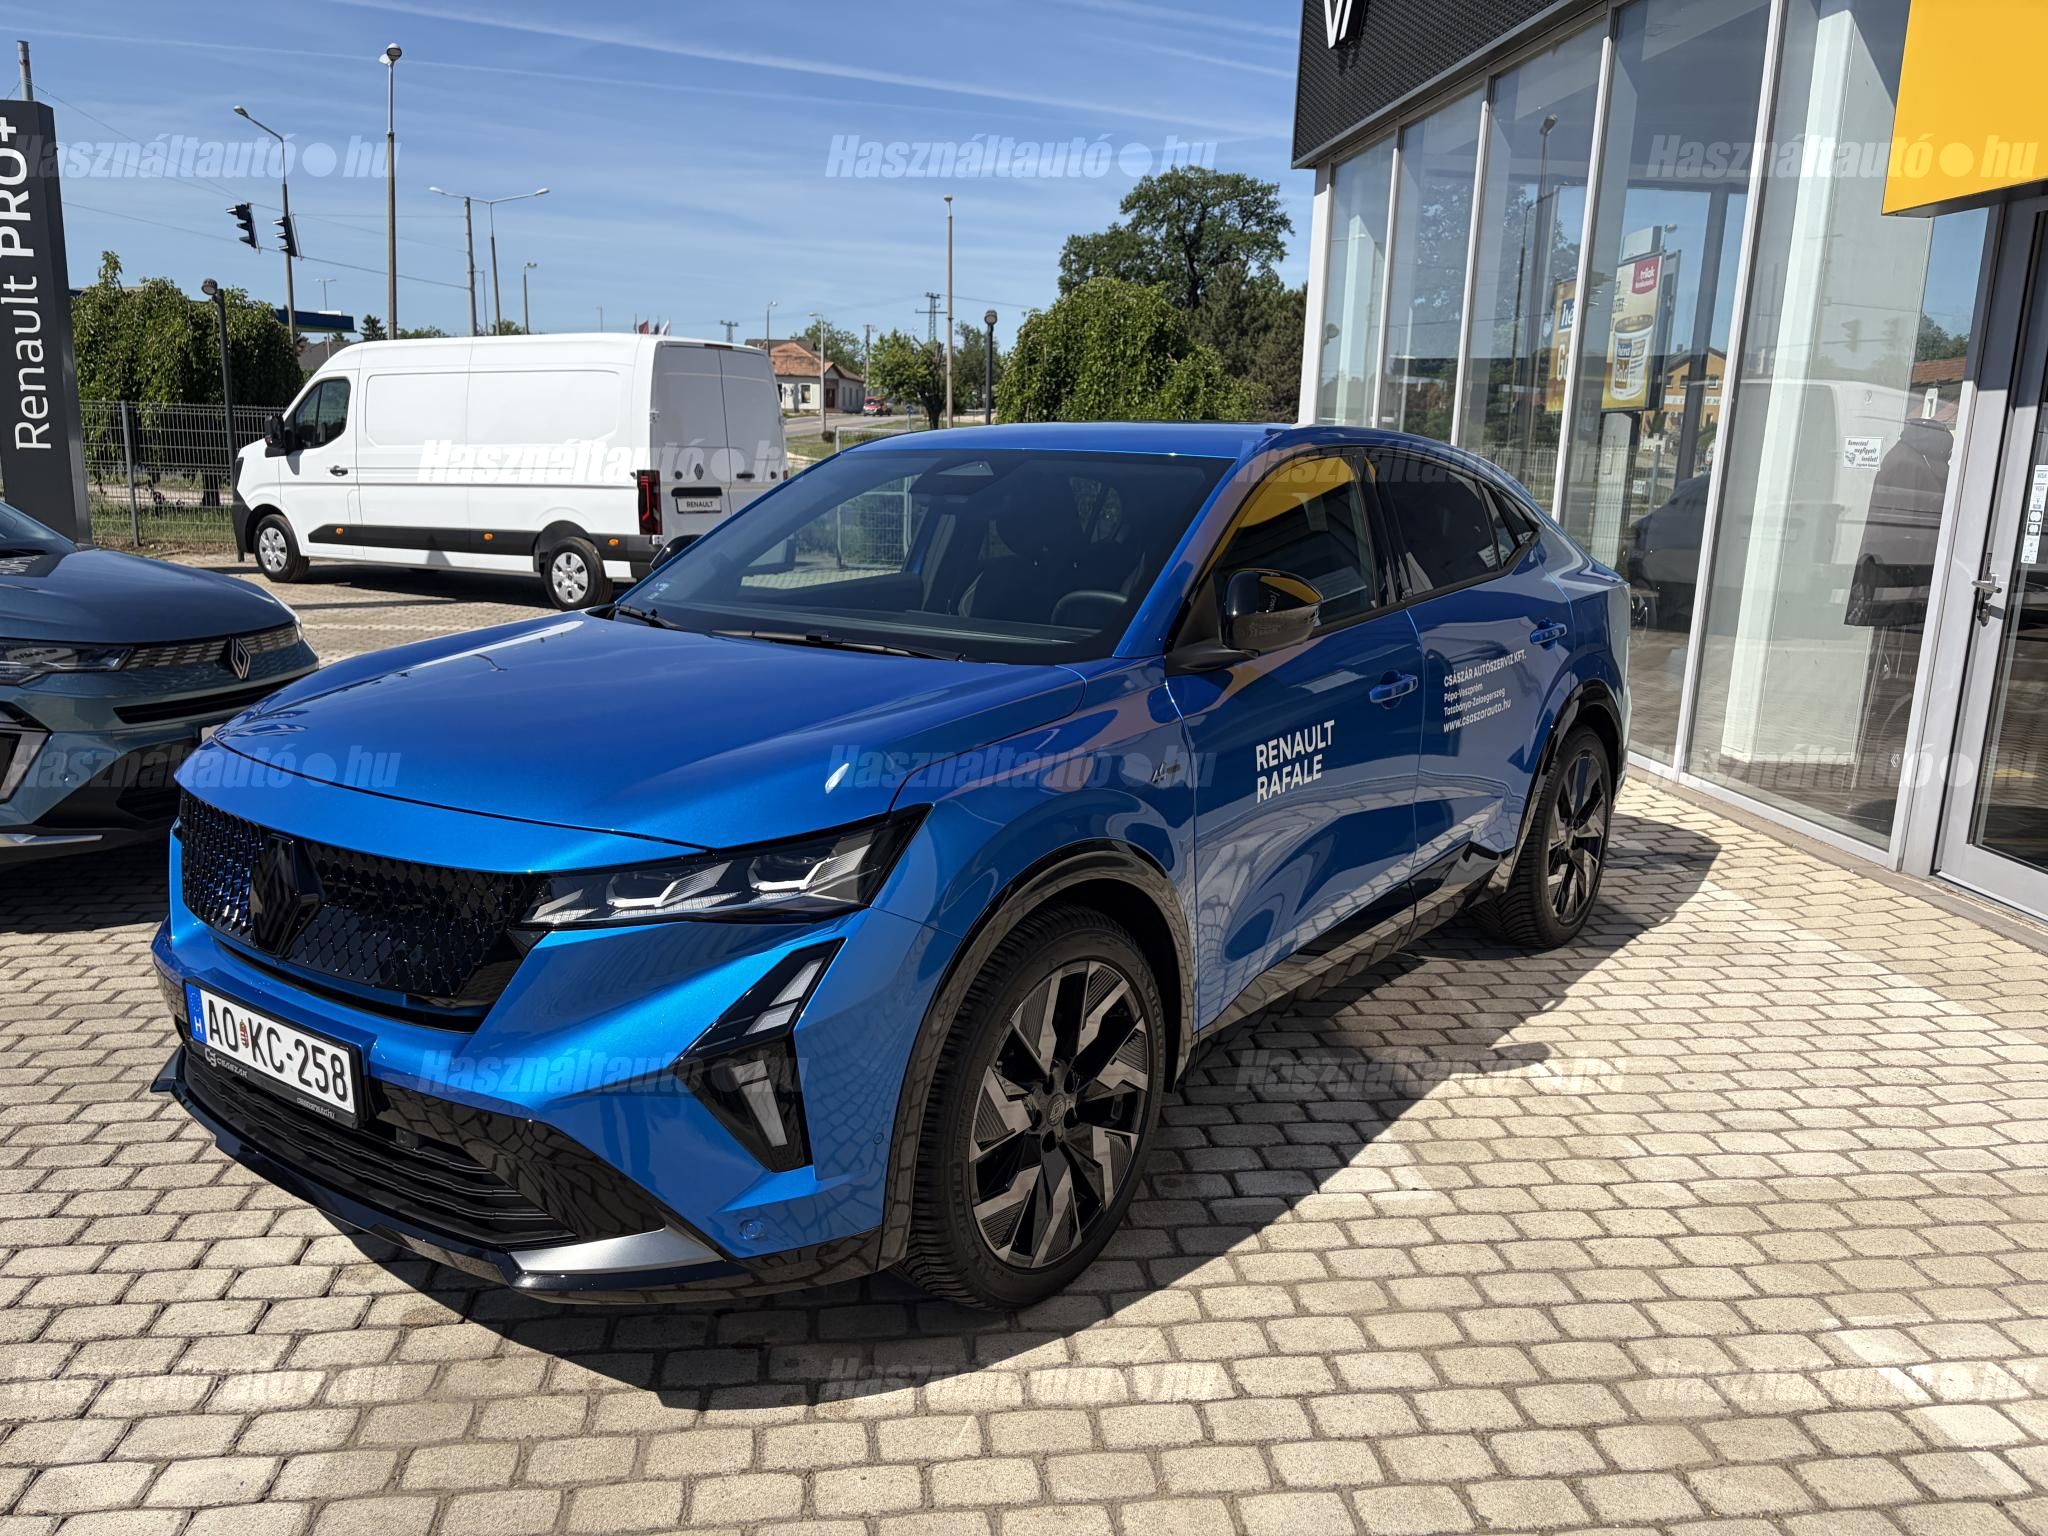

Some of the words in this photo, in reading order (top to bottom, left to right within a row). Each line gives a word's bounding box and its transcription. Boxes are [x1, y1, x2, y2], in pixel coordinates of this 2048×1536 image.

[0, 116, 35, 257] PRO+
[1, 275, 52, 450] Renault
[1443, 666, 1473, 687] CSÁSZÁR
[1474, 653, 1514, 678] AUTÓSZERVIZ
[1514, 649, 1527, 663] KFT.
[1443, 699, 1512, 733] www.csaszarauto.hu
[1255, 720, 1335, 772] RENAULT
[1256, 754, 1323, 803] RAFALE
[194, 1016, 203, 1034] H
[208, 999, 239, 1052] AO
[247, 1017, 348, 1102] KC-258
